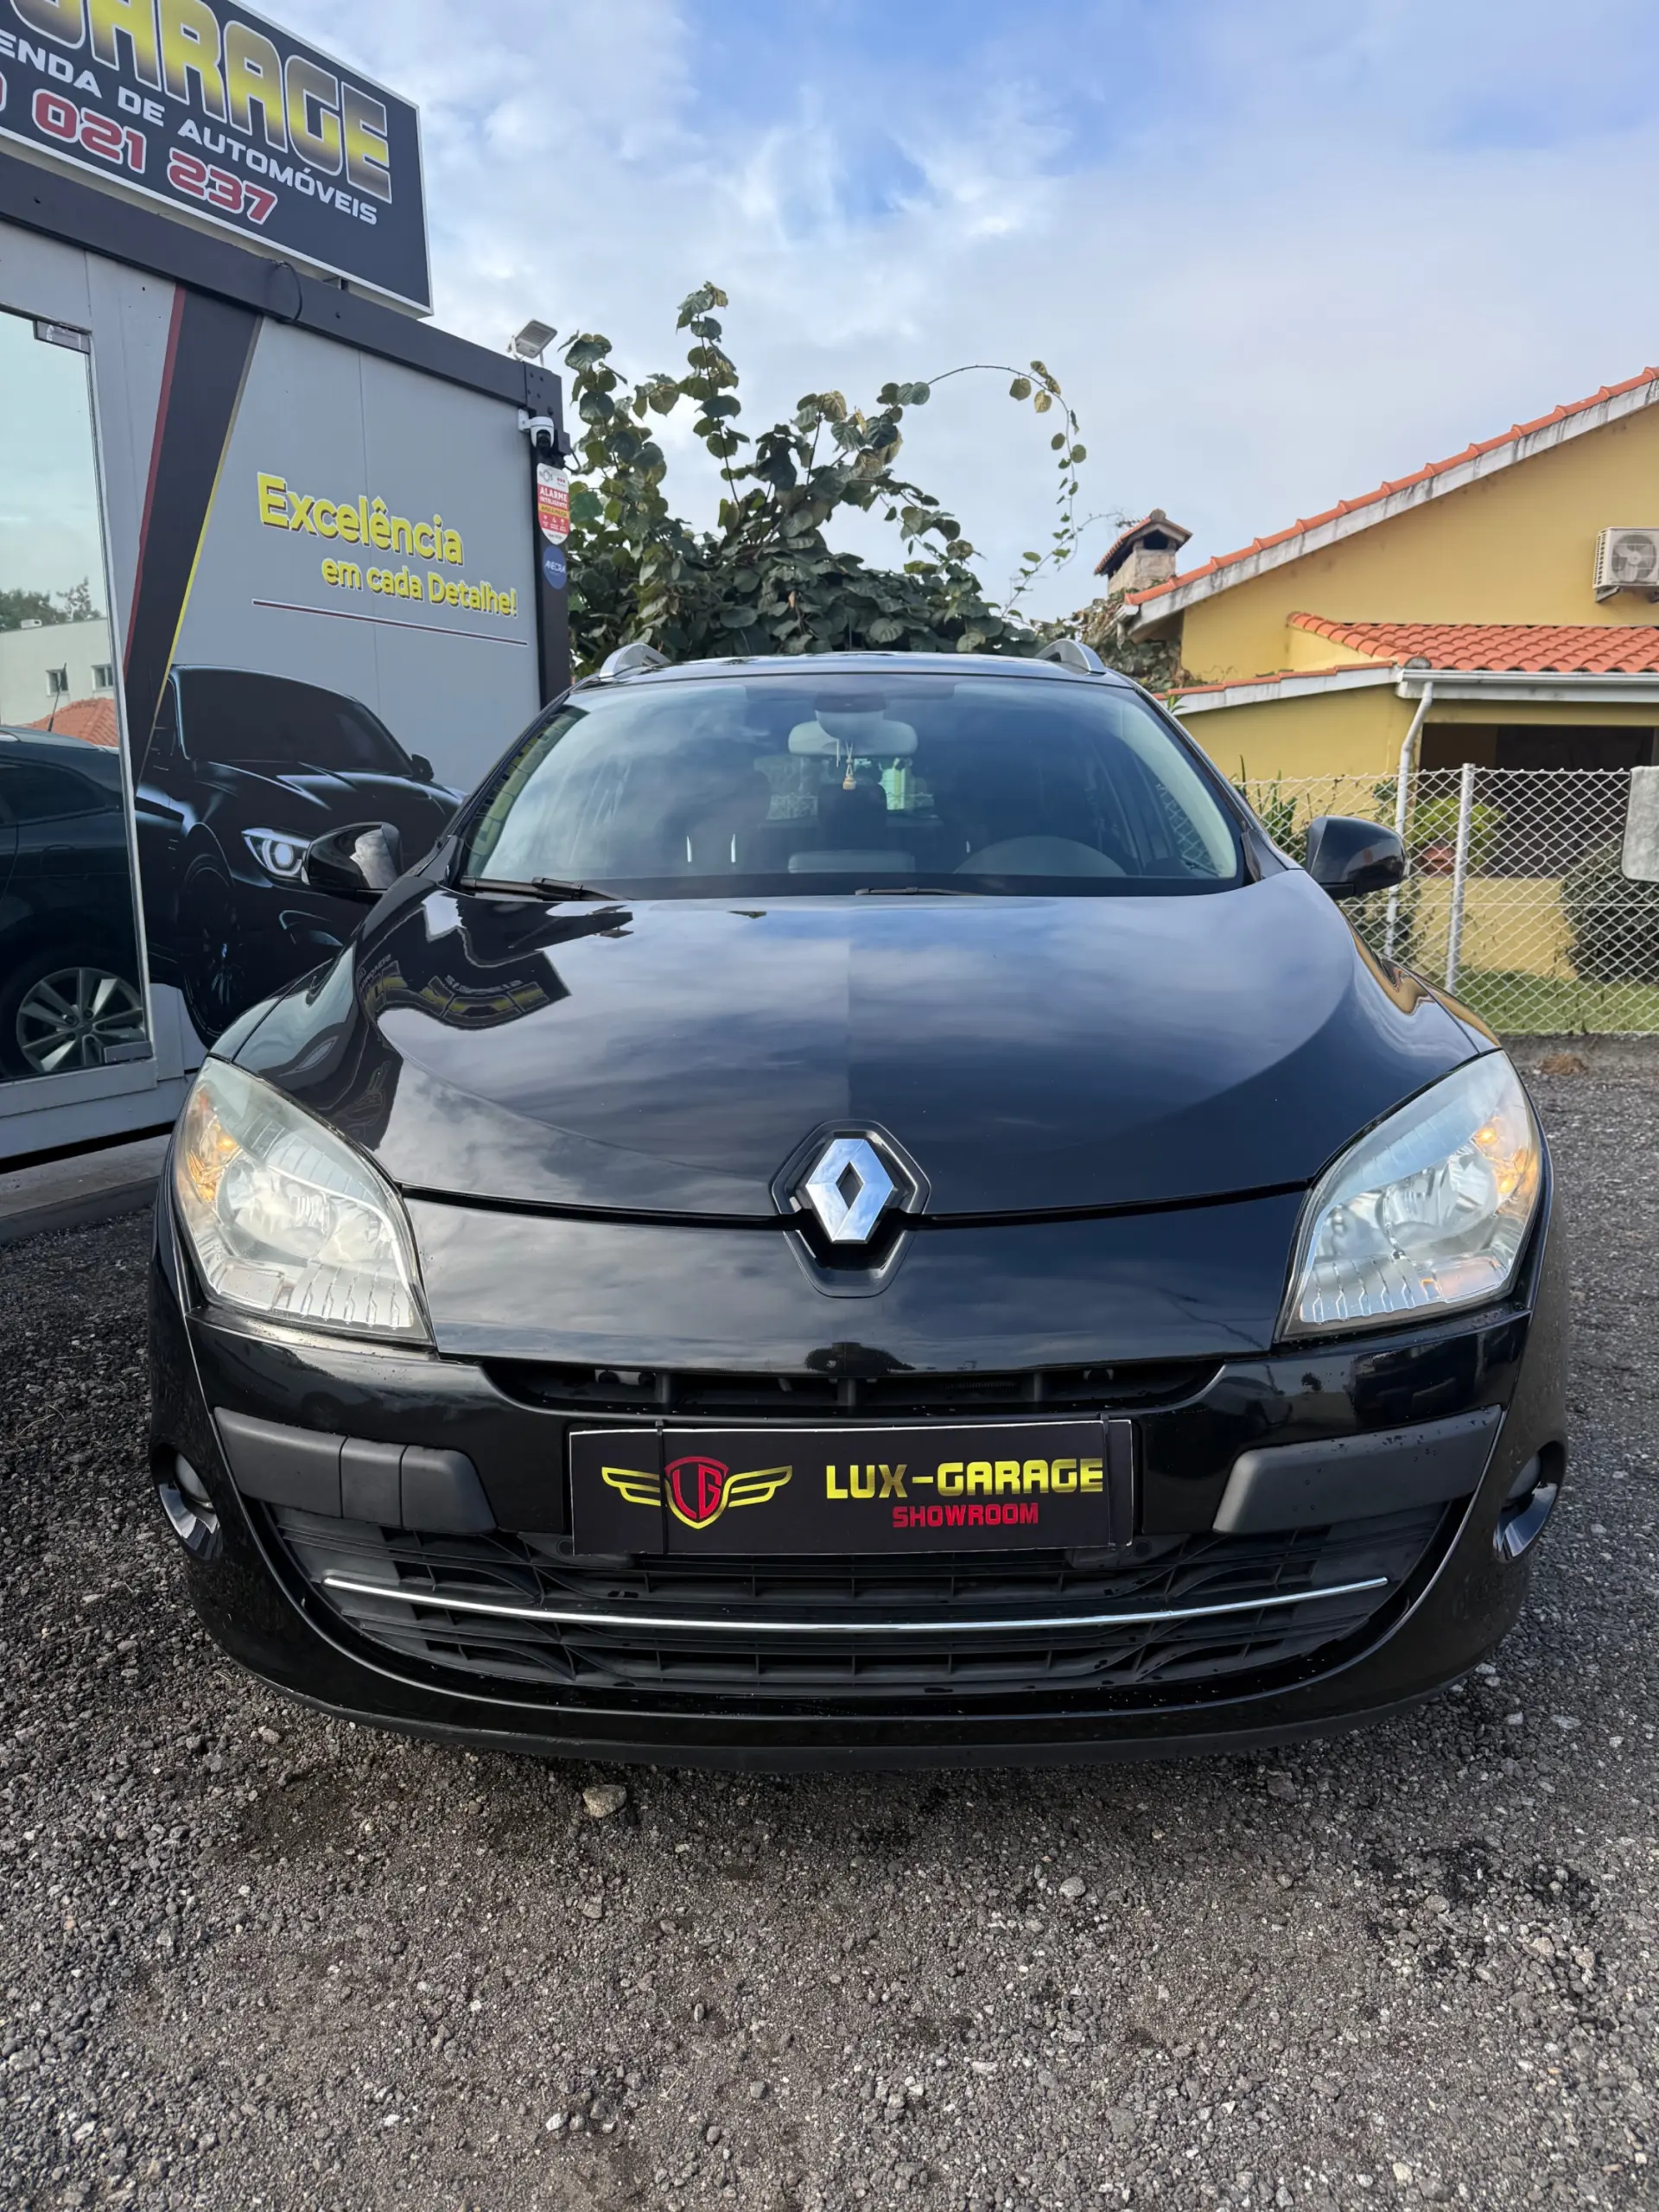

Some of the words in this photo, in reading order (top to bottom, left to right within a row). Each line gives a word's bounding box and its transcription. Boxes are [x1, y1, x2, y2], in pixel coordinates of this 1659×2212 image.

[32, 88, 146, 174] 021
[167, 147, 277, 225] 237
[118, 86, 165, 128] DE
[178, 118, 378, 225] AUTOMÓVEIS
[257, 471, 465, 566] Excelência
[539, 486, 569, 503] ALARME
[321, 557, 363, 590] em
[366, 565, 423, 601] cada
[428, 571, 518, 618] Detalhe!
[825, 1458, 1104, 1499] LUX-GARAGE
[892, 1502, 1039, 1529] SHOWROOM
